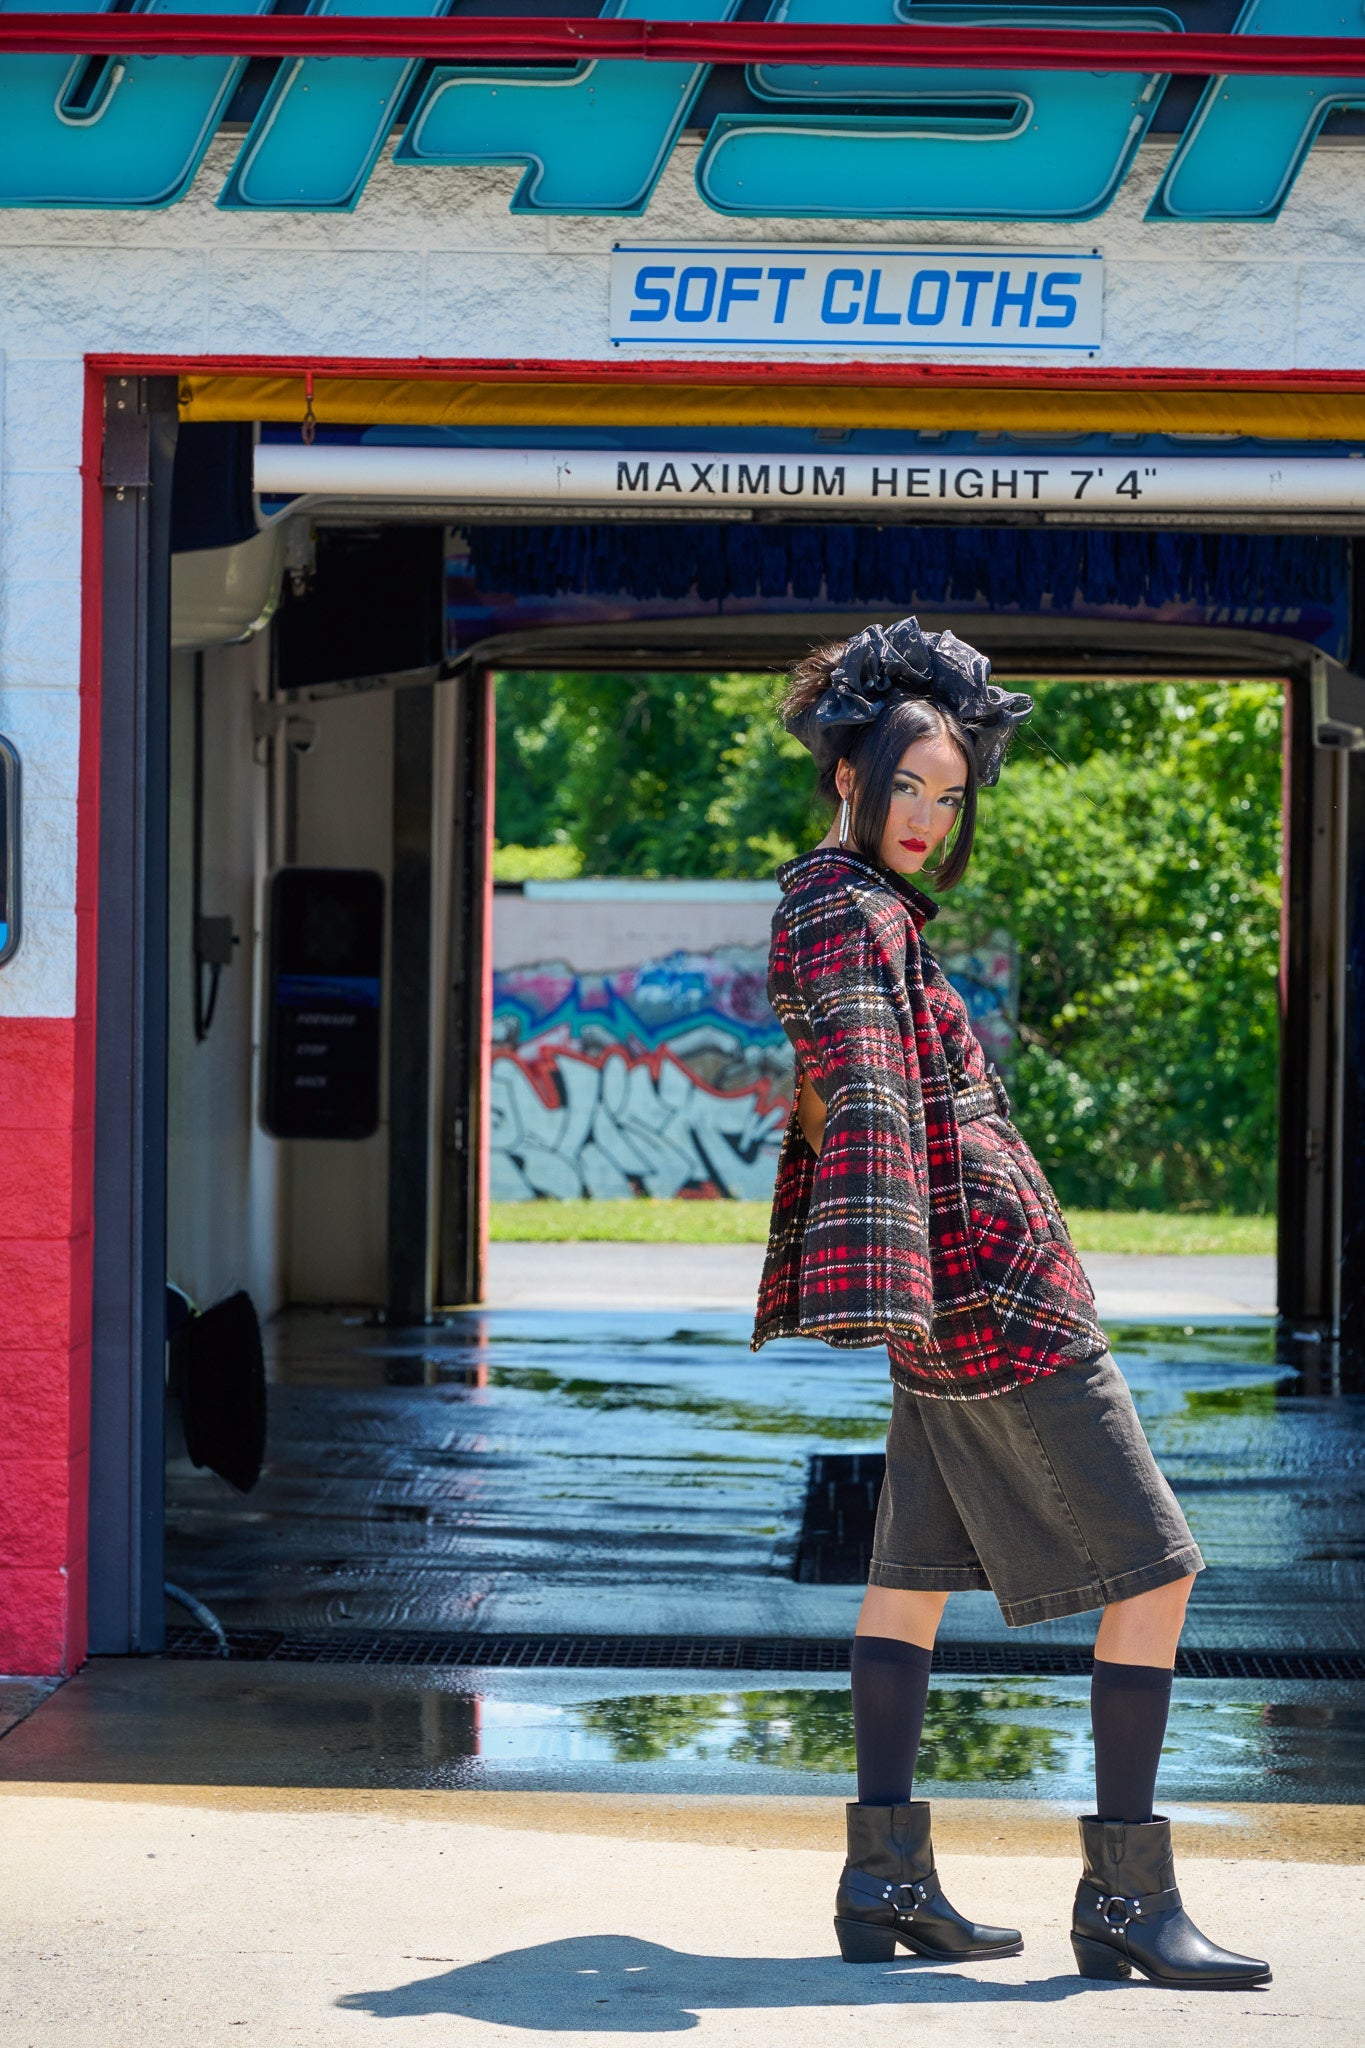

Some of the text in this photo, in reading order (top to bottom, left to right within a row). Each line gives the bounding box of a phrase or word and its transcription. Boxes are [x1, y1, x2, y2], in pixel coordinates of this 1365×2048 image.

[629, 265, 1080, 328] SOFT CLOTHS
[616, 460, 846, 497] MAXIMUM
[871, 466, 1049, 500] HEIGHT
[1204, 606, 1302, 624] TANDEM
[296, 1043, 327, 1056] STOP
